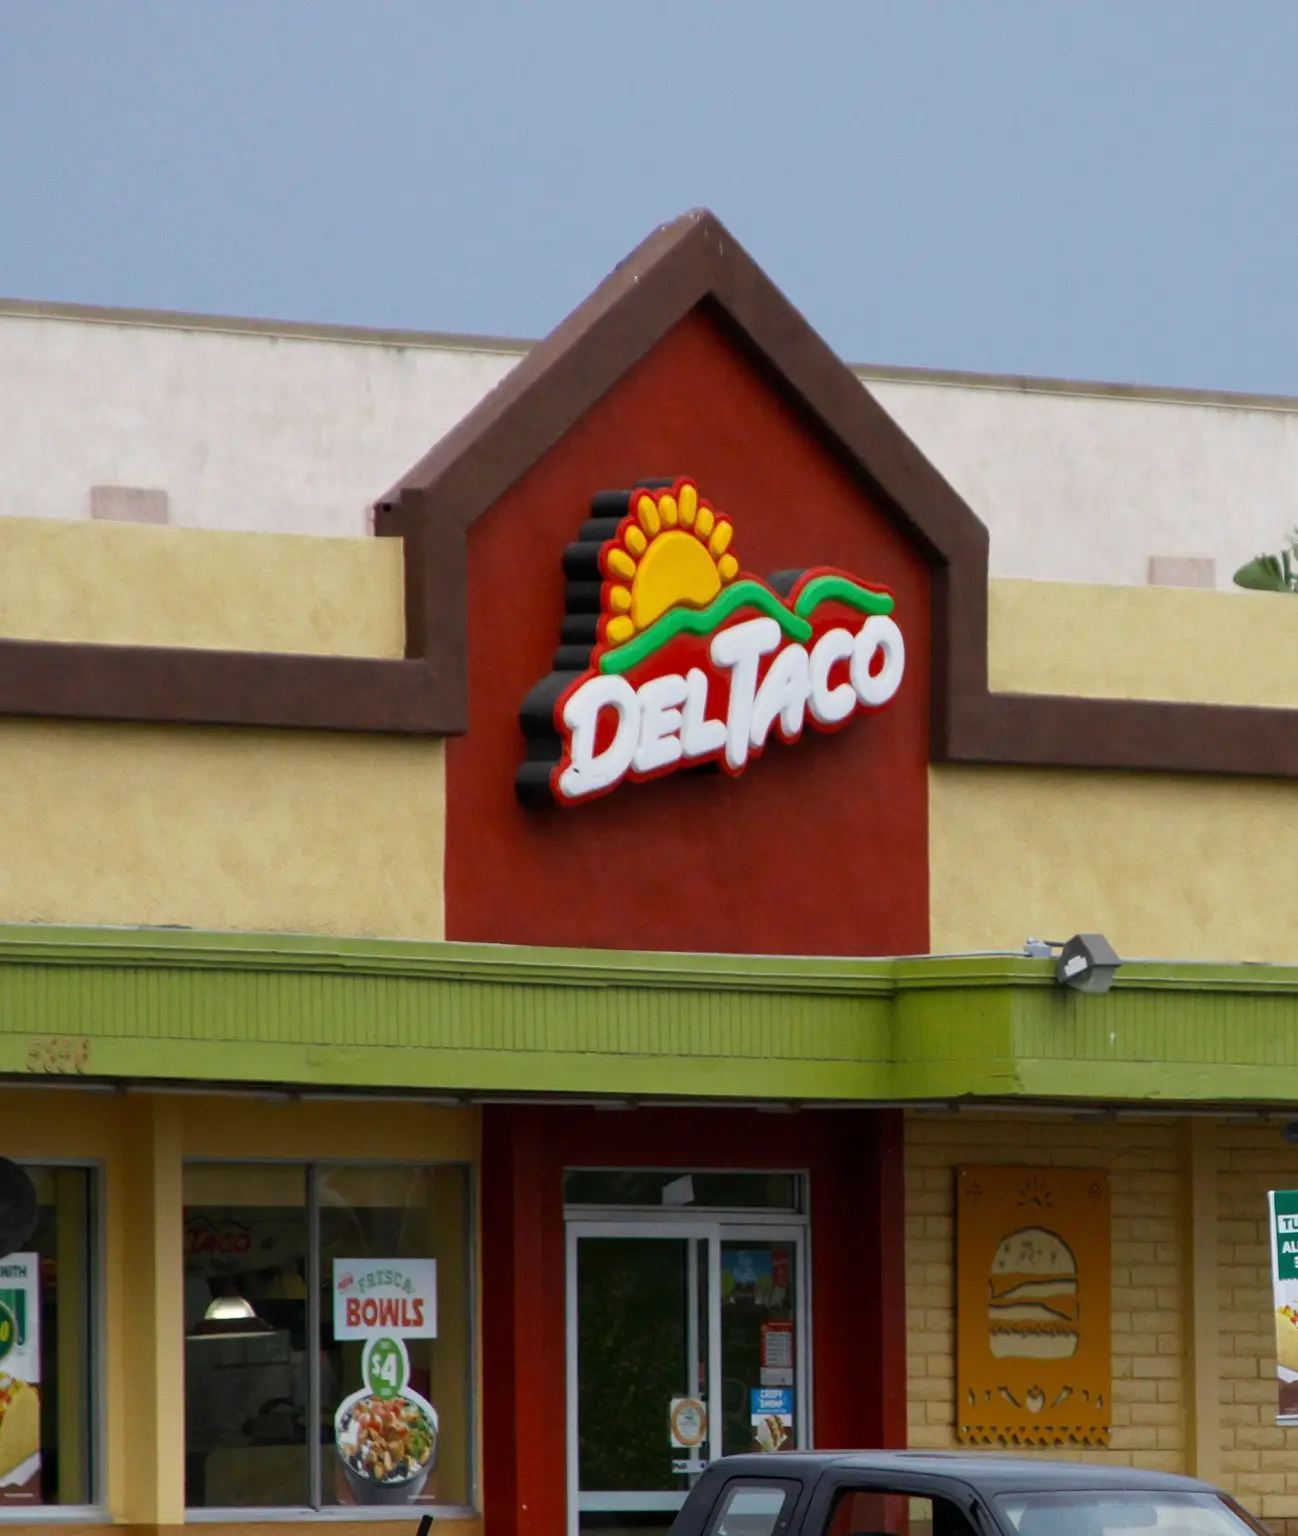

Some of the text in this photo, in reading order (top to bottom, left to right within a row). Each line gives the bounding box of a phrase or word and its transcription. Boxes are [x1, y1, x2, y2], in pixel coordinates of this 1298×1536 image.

[558, 615, 905, 799] DEL TACO
[357, 1269, 413, 1294] FRESCA
[346, 1297, 425, 1327] BOWLS
[371, 1352, 397, 1387] $4
